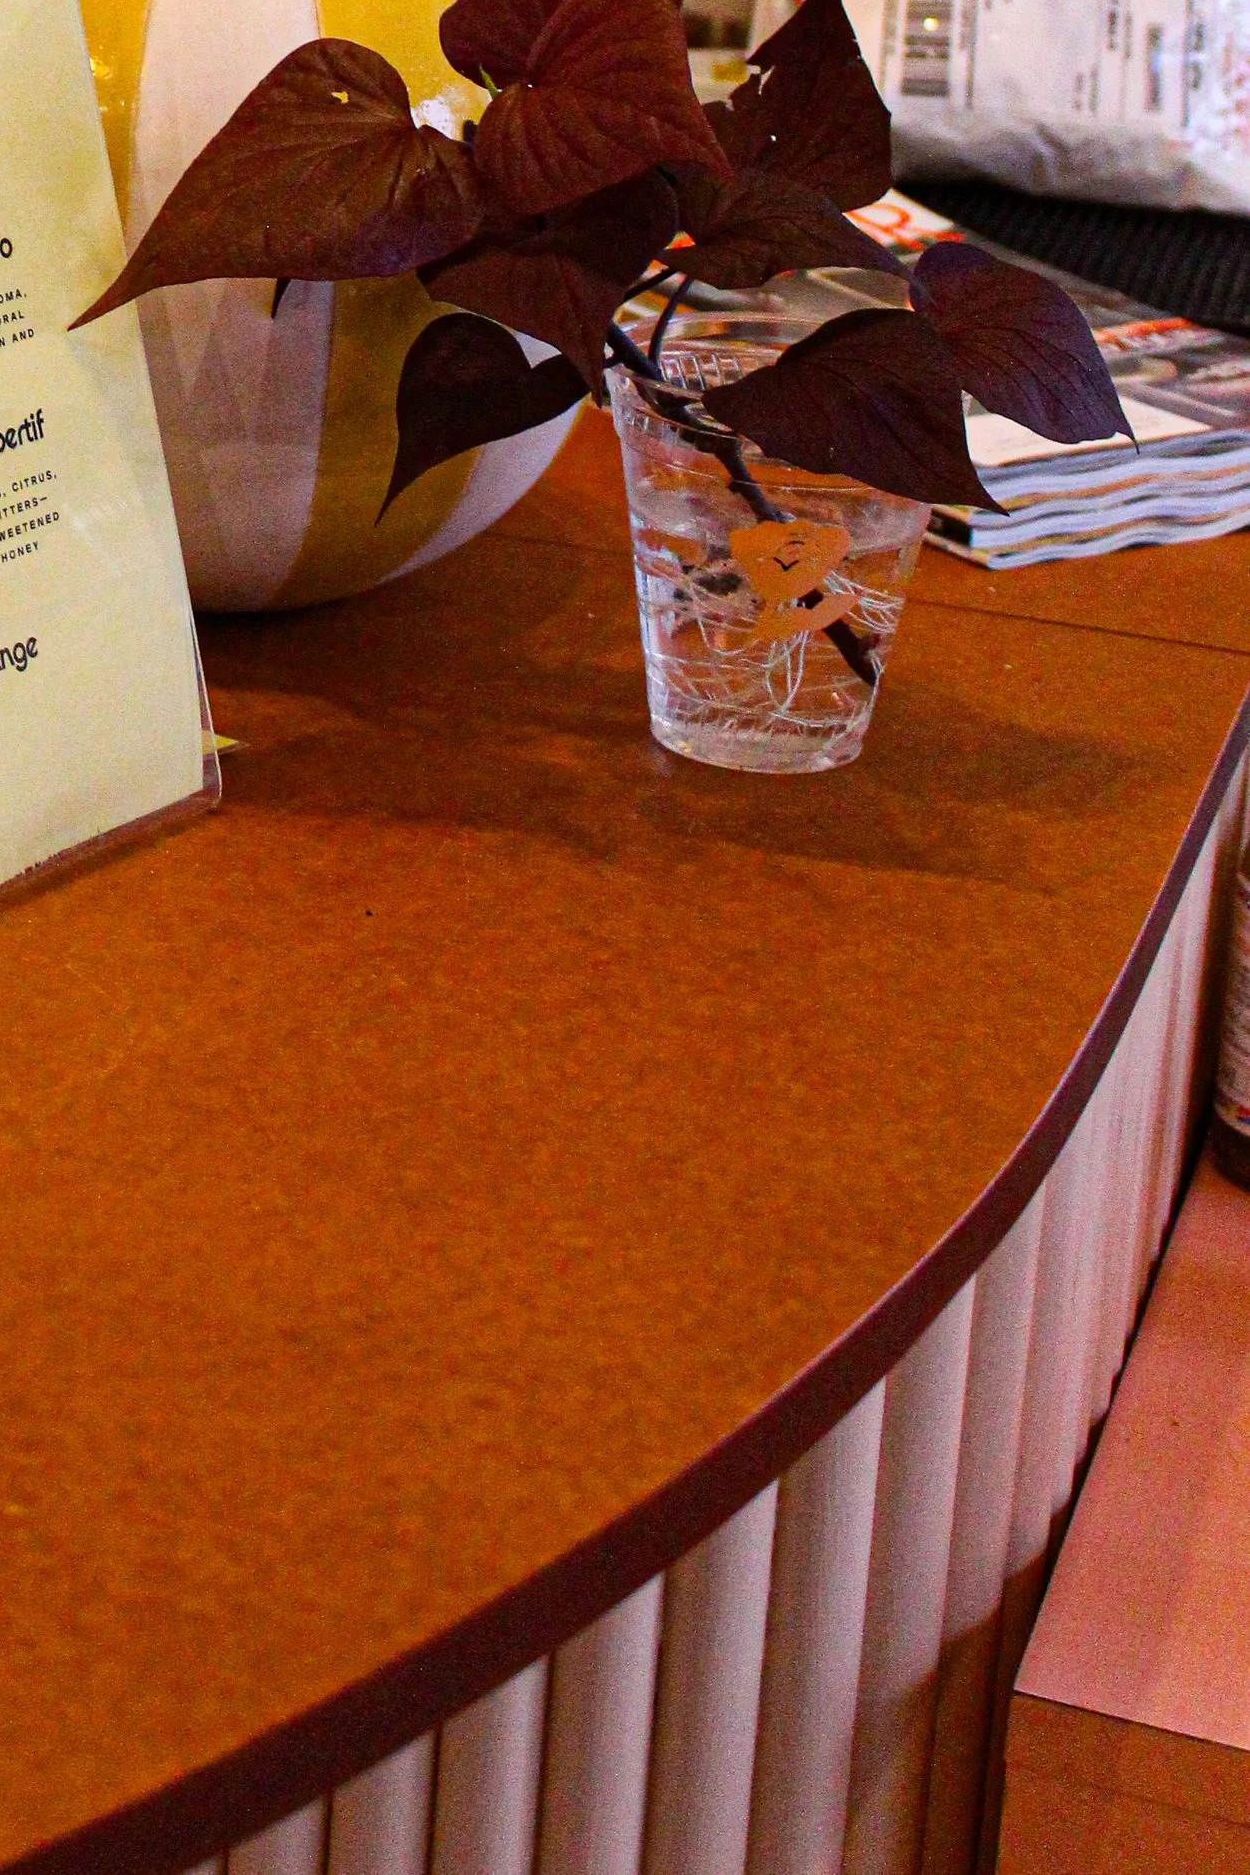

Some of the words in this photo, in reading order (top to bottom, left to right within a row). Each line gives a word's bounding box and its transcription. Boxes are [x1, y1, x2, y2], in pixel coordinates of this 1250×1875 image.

[12, 329, 34, 342] AND
[12, 470, 56, 492] CITRUS,
[1, 542, 38, 562] HONEY
